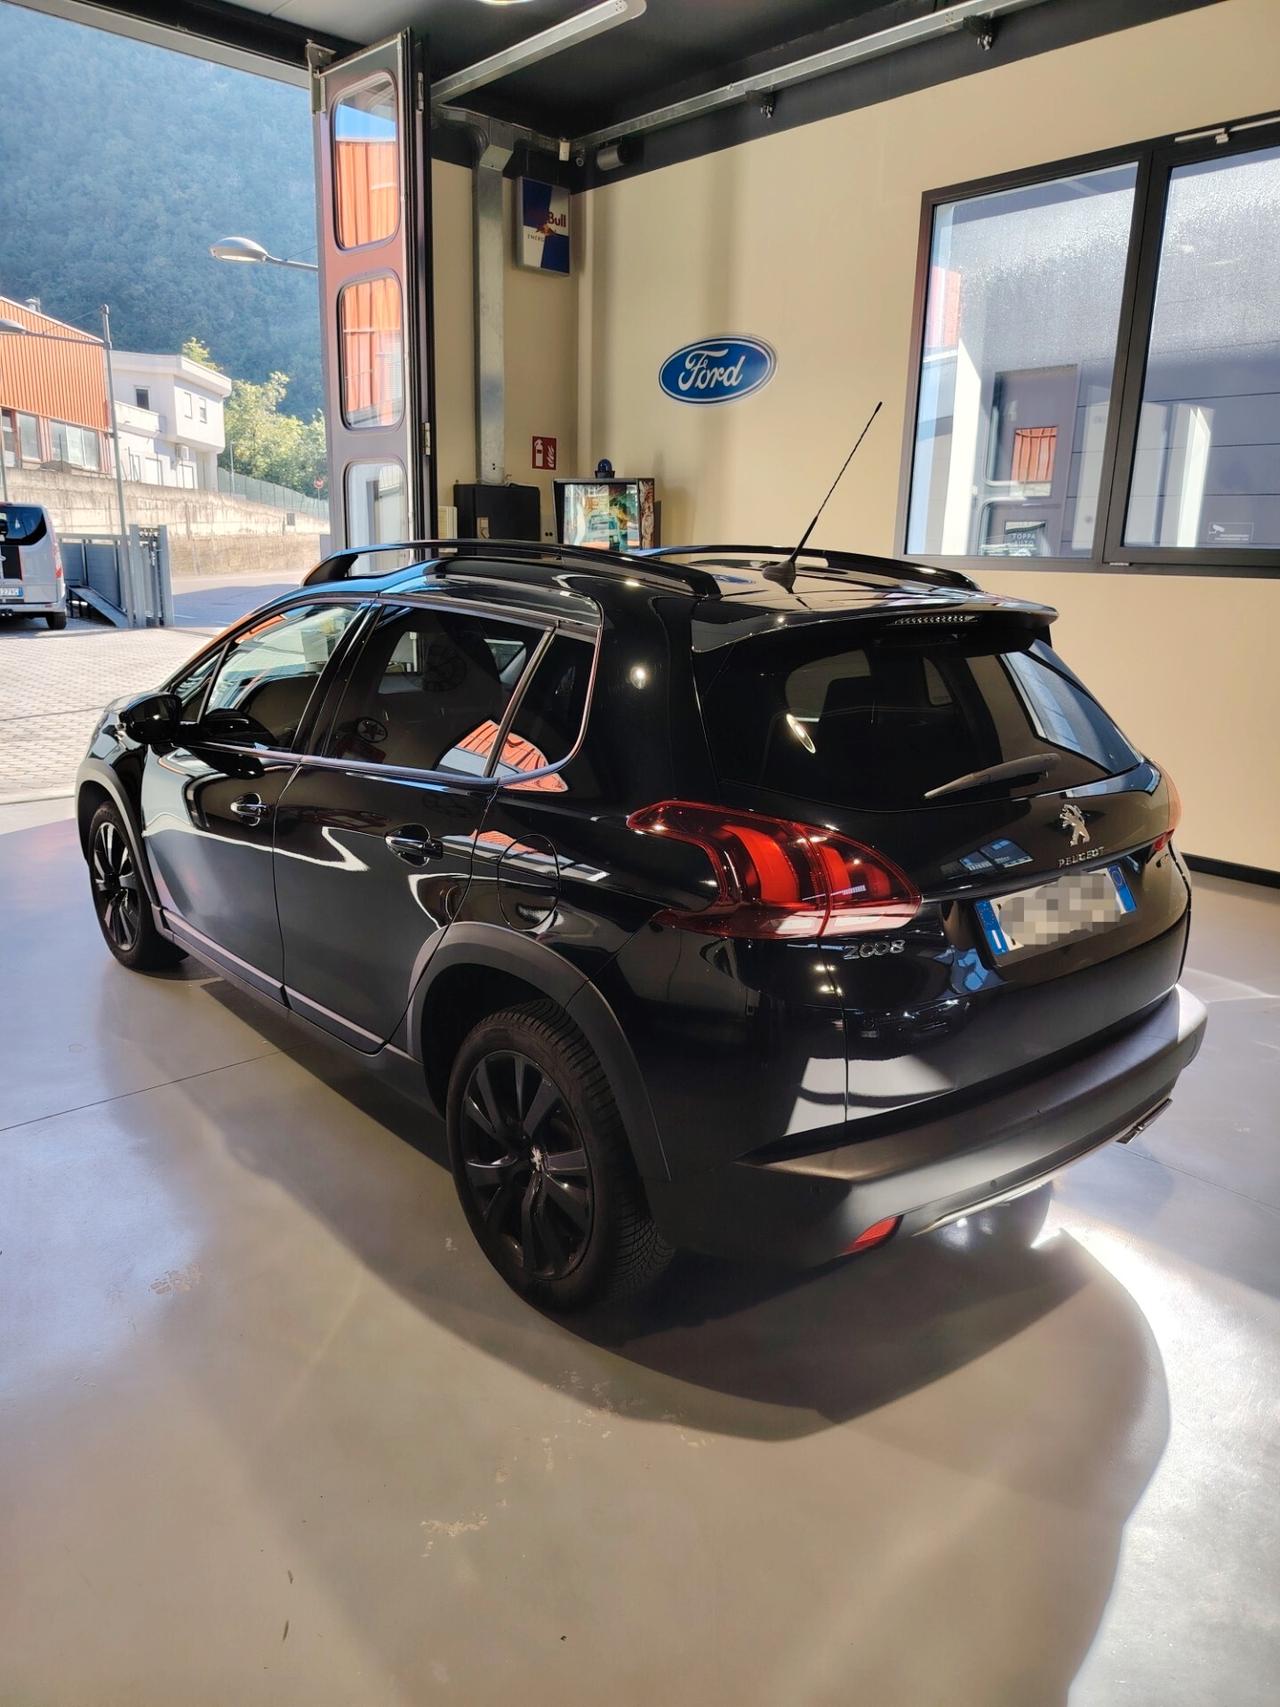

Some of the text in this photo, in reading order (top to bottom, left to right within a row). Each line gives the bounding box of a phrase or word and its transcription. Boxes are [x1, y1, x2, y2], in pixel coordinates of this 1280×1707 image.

[546, 212, 567, 228] Bull
[678, 349, 746, 391] Ford
[1058, 846, 1104, 868] PEUGEOT
[843, 940, 906, 960] 2008
